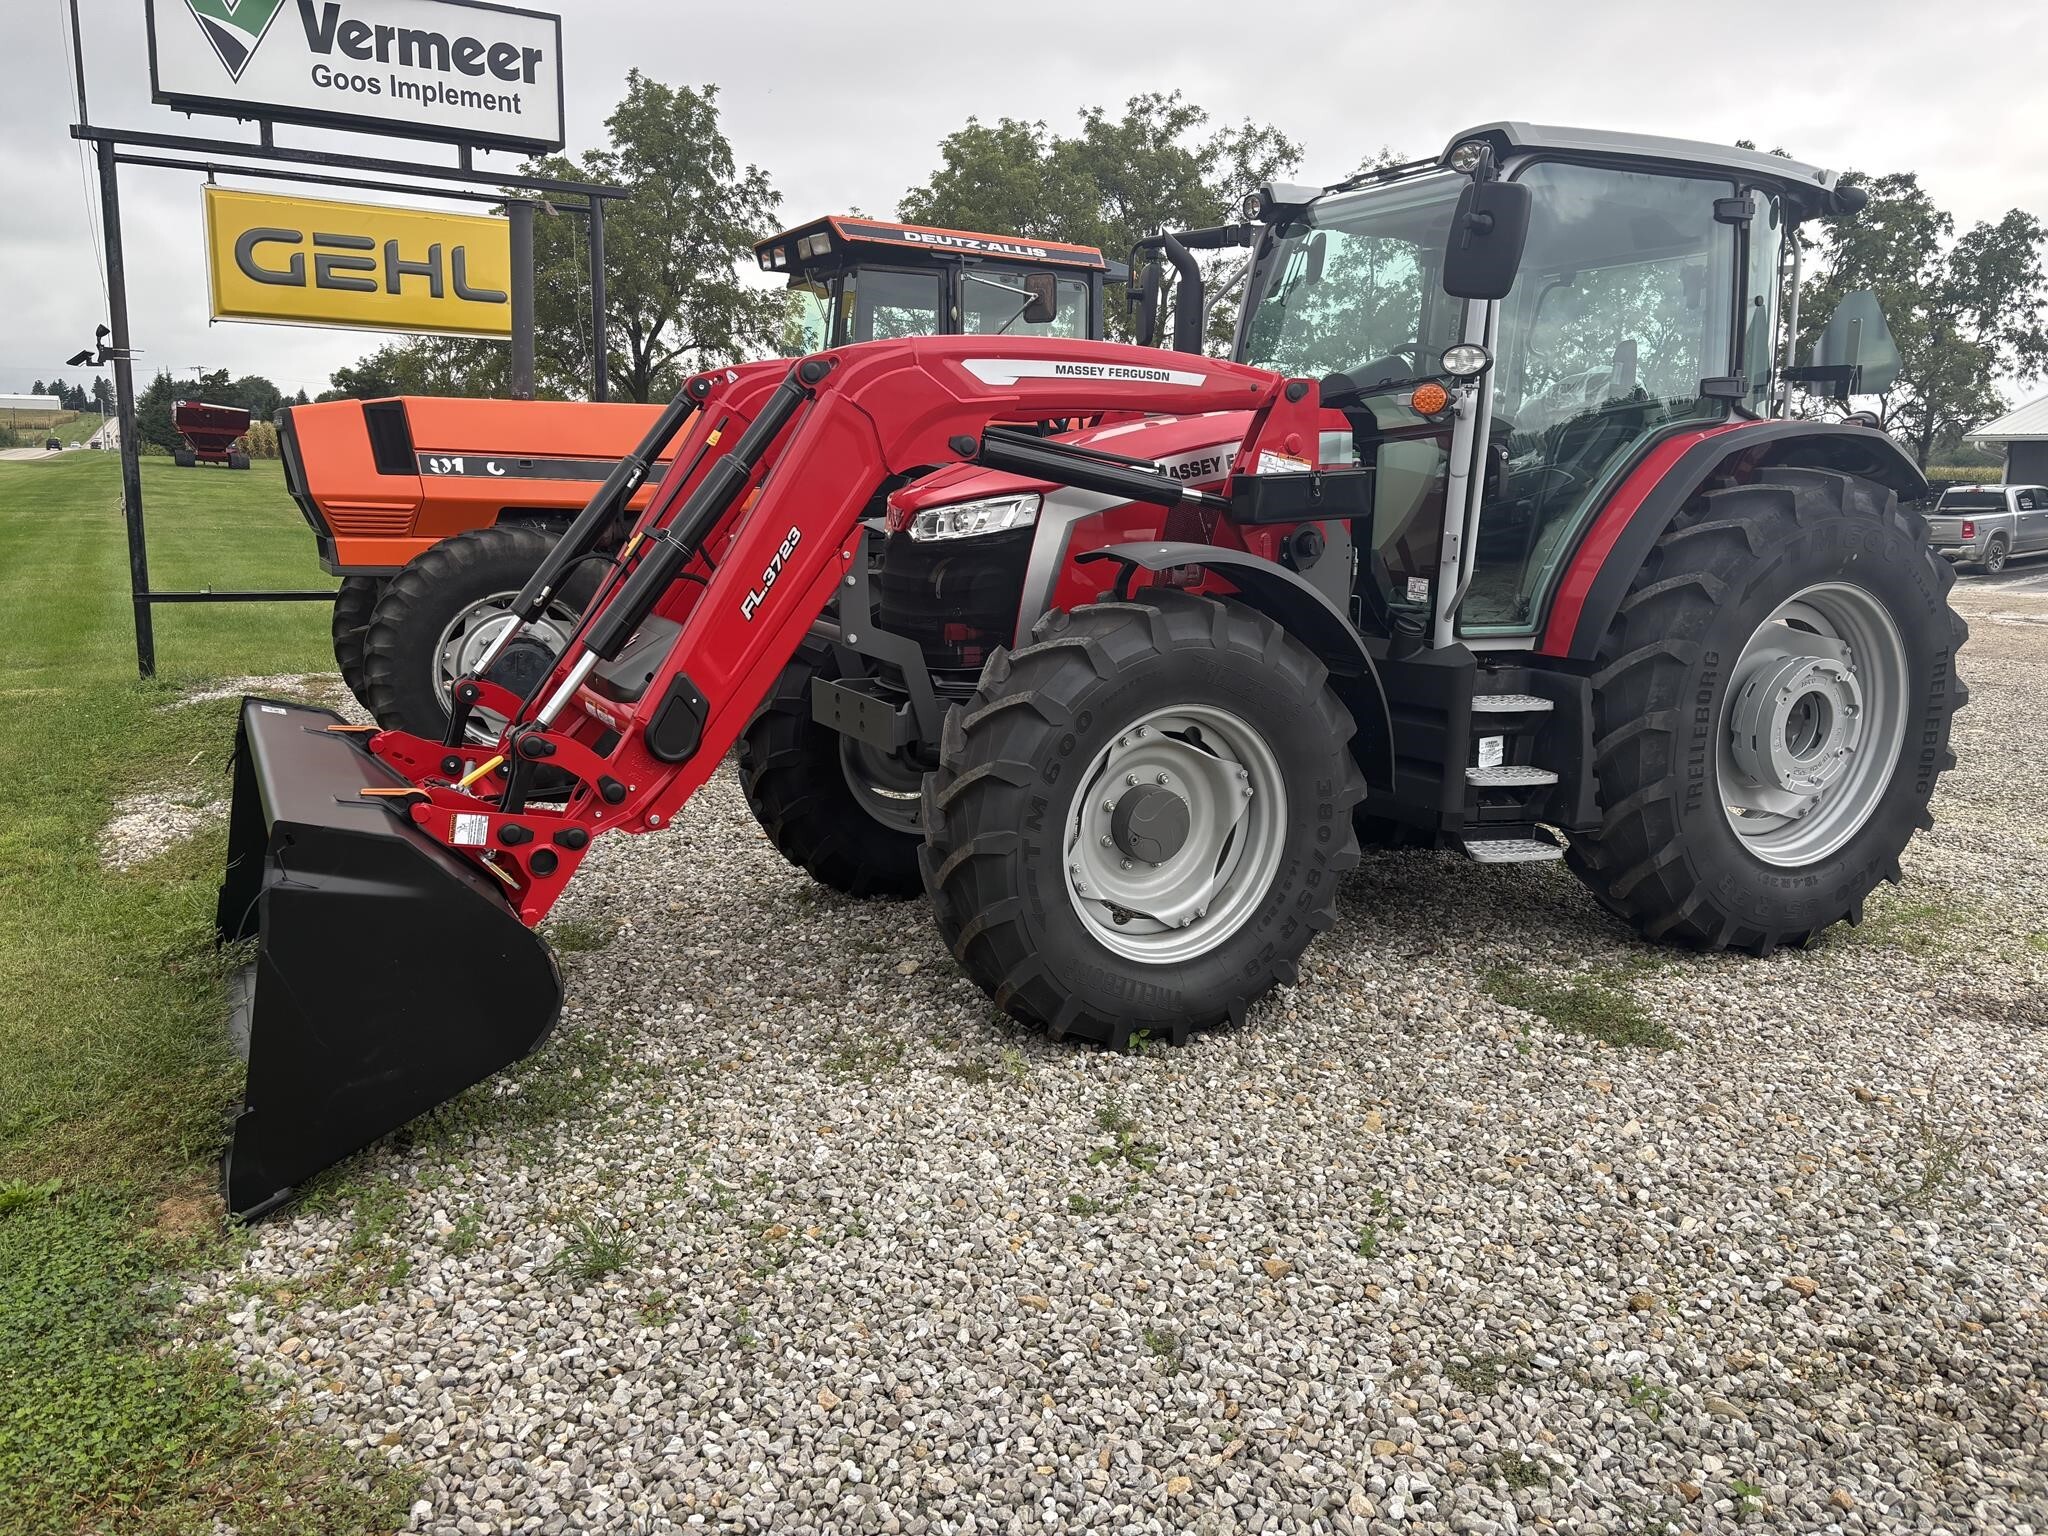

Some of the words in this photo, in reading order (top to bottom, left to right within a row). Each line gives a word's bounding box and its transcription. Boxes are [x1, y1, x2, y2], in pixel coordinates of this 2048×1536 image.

[296, 0, 542, 84] Vermeer
[311, 64, 381, 95] Goos
[390, 74, 523, 115] Implement
[234, 226, 508, 305] GEHL
[903, 231, 1048, 258] DEUTZ-ALLIS
[1055, 364, 1105, 377] MASSEY
[1108, 367, 1171, 382] FERGUSON
[740, 526, 801, 621] FL.3723
[1684, 650, 1720, 816] TRELLEBORG
[1915, 645, 1949, 794] TRELLEBORG
